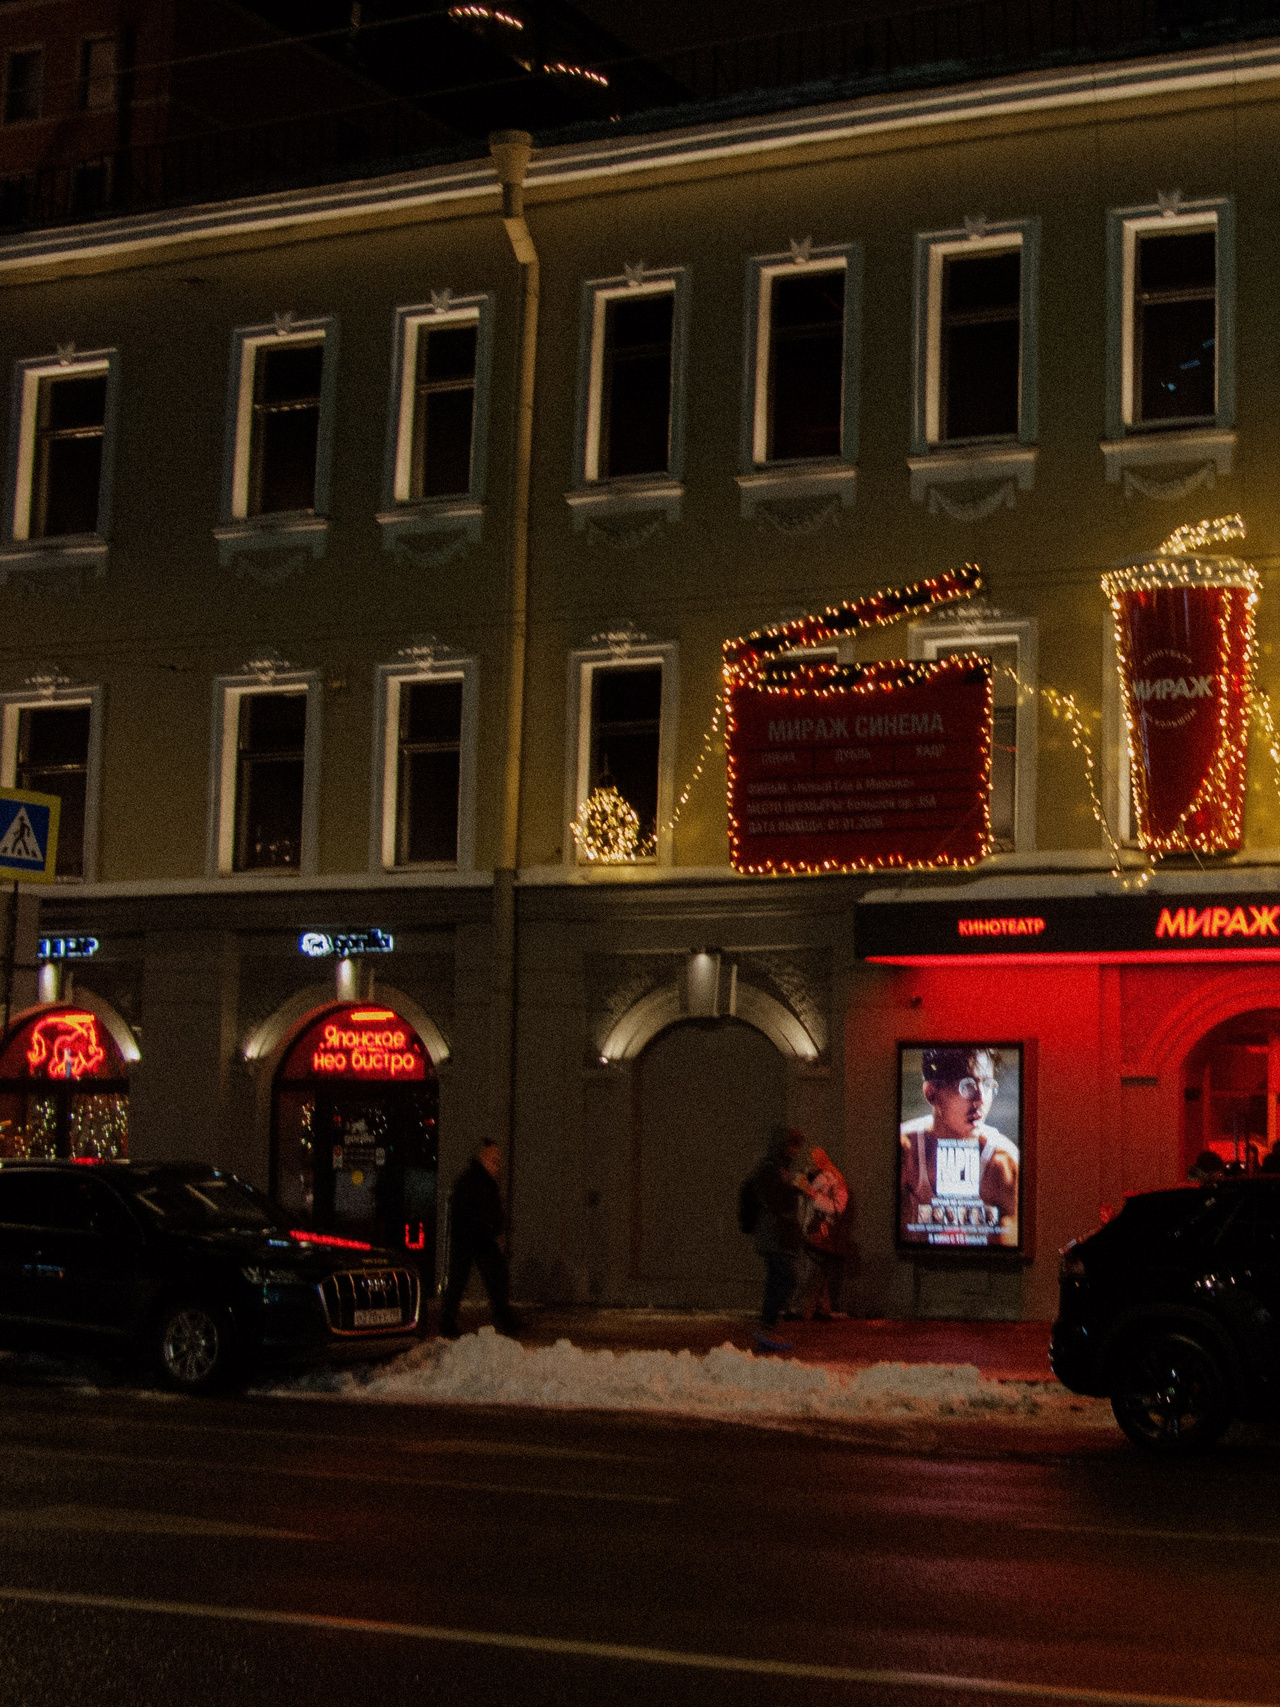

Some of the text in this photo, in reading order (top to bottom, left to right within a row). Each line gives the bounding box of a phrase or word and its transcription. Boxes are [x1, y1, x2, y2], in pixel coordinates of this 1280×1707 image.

[768, 712, 944, 742] МИРАЖ СИНЕМА
[958, 917, 1046, 937] КИНОТЕАТР
[324, 1024, 406, 1049] Японское
[313, 1047, 415, 1077] нео бистро
